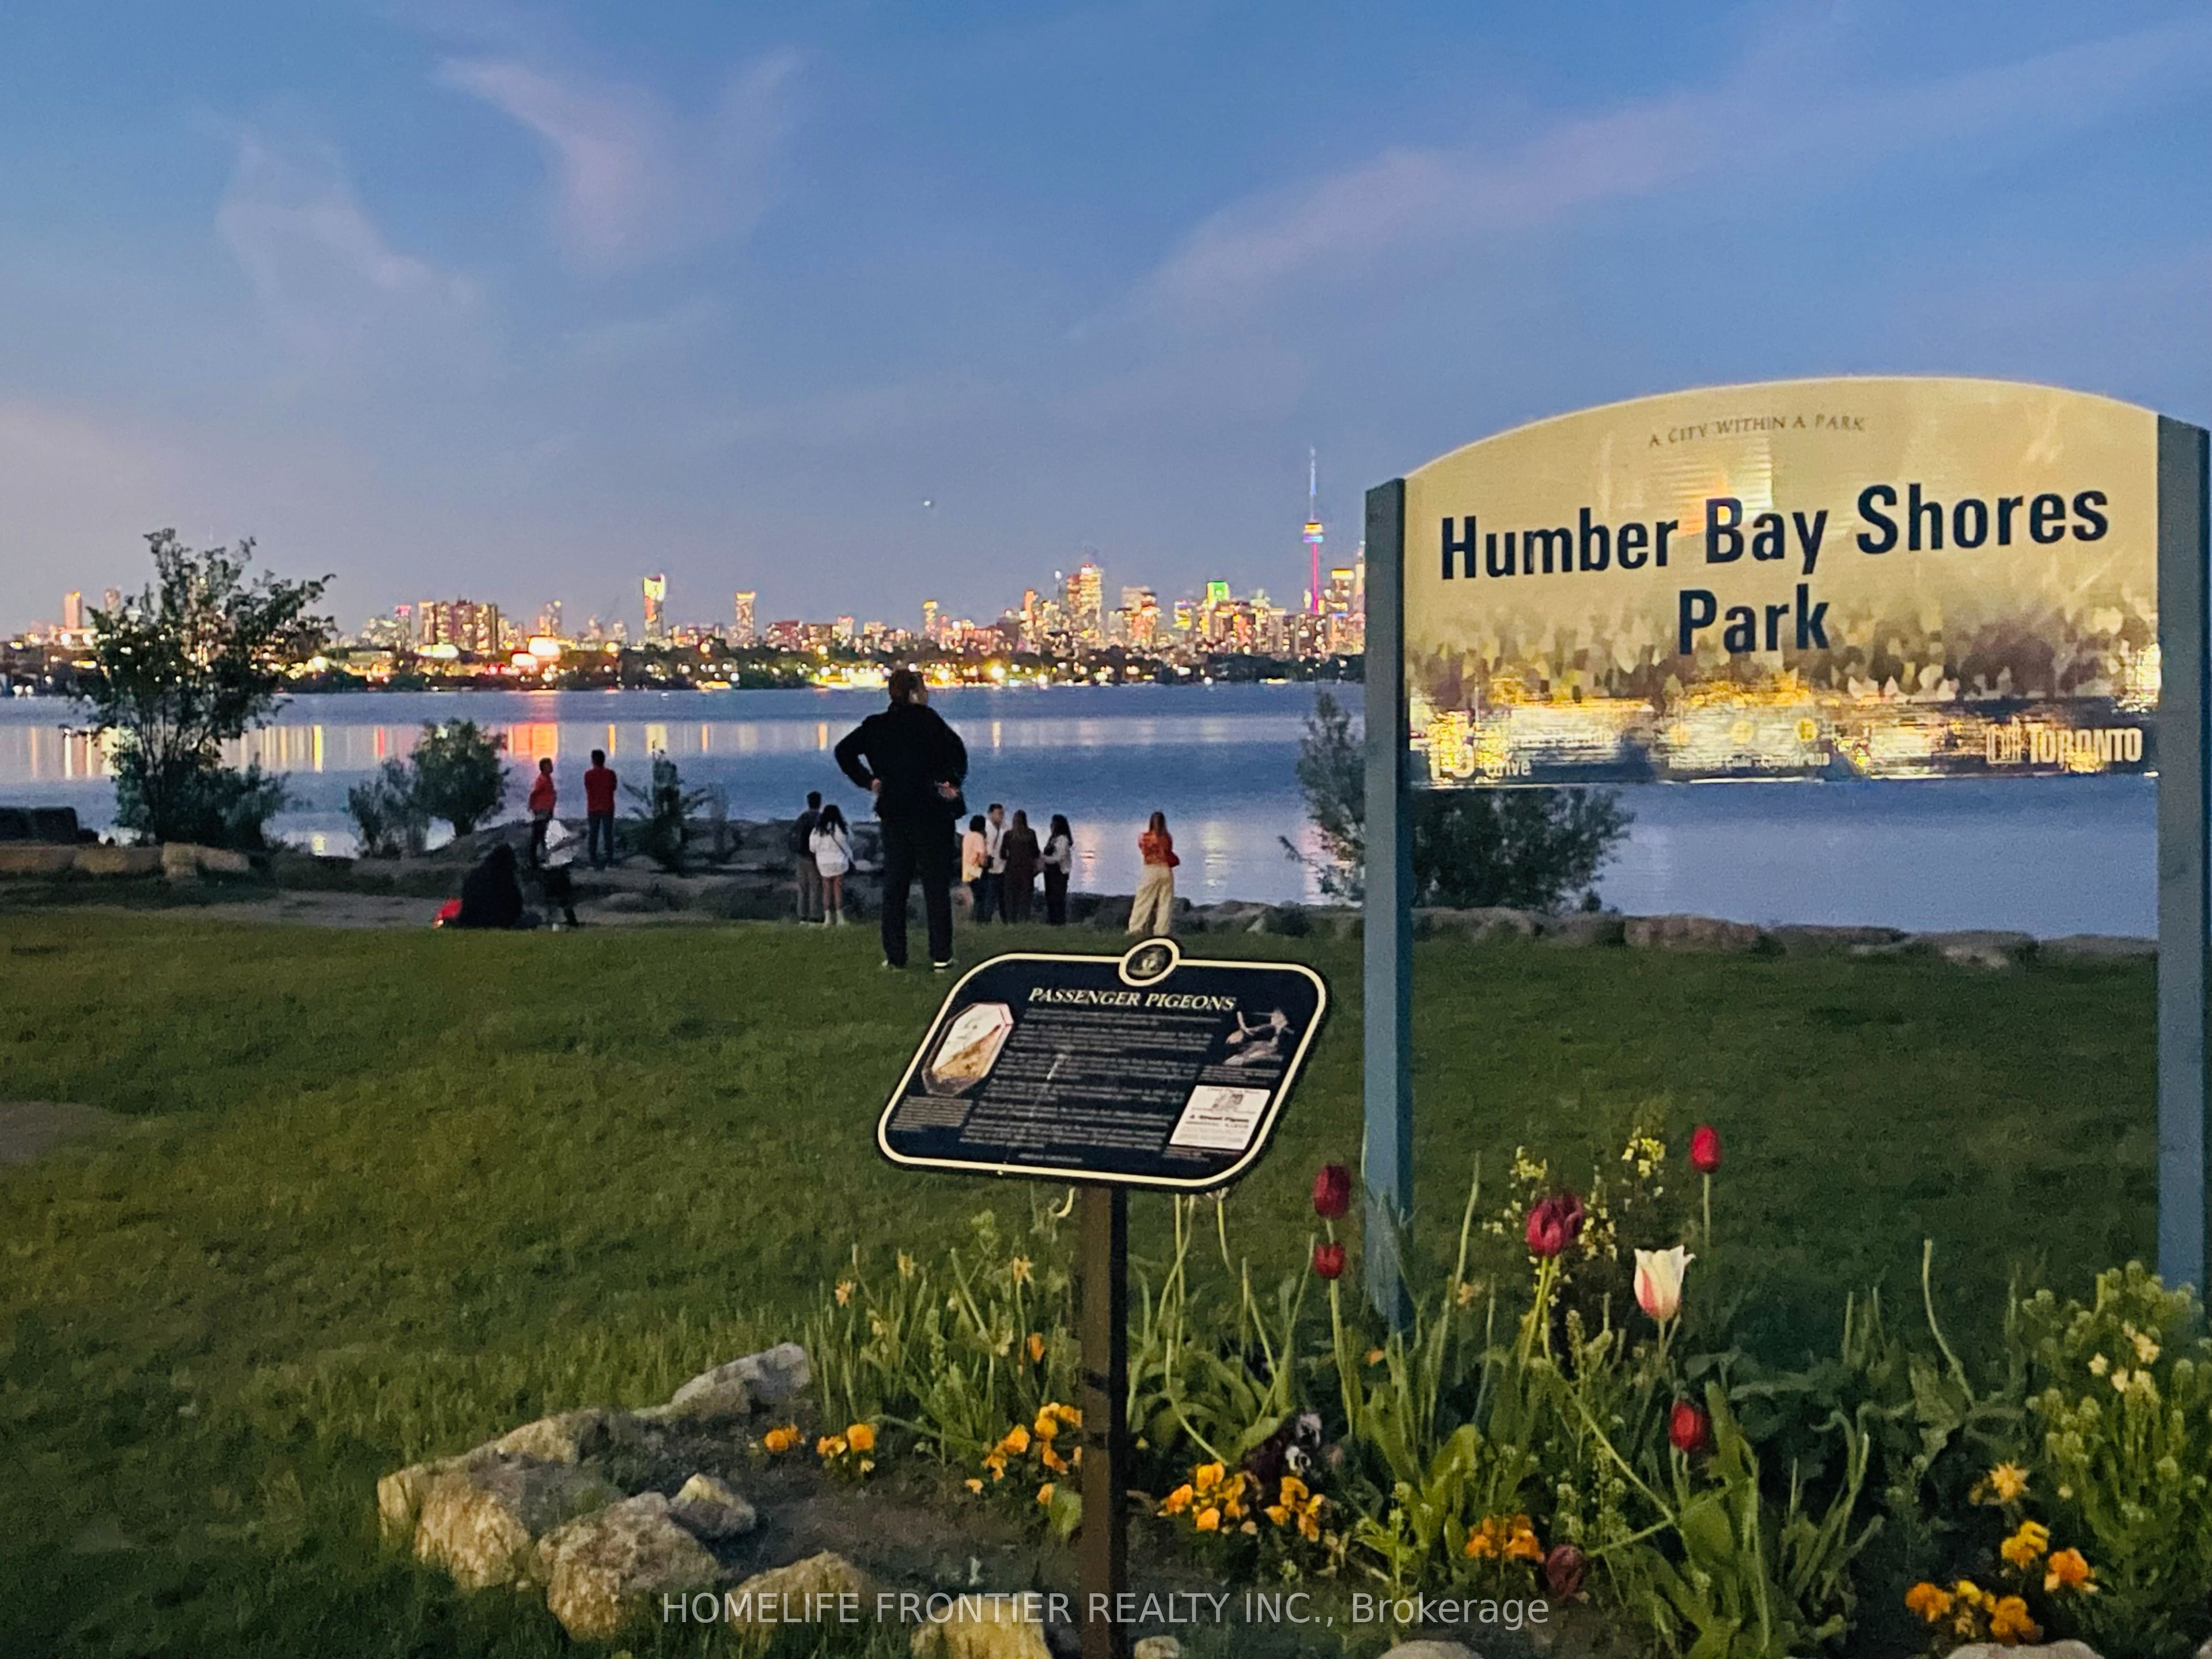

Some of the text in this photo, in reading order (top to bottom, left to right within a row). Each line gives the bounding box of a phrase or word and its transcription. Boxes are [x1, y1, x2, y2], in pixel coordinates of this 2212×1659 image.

[1649, 414, 1866, 448] A CITY WITHIN A PARK
[1442, 483, 2108, 579] Humber Bay Shores
[1679, 583, 1830, 655] Park
[2025, 722, 2143, 764] TORONTO
[1028, 987, 1237, 1010] PASSENGER PIGEONS
